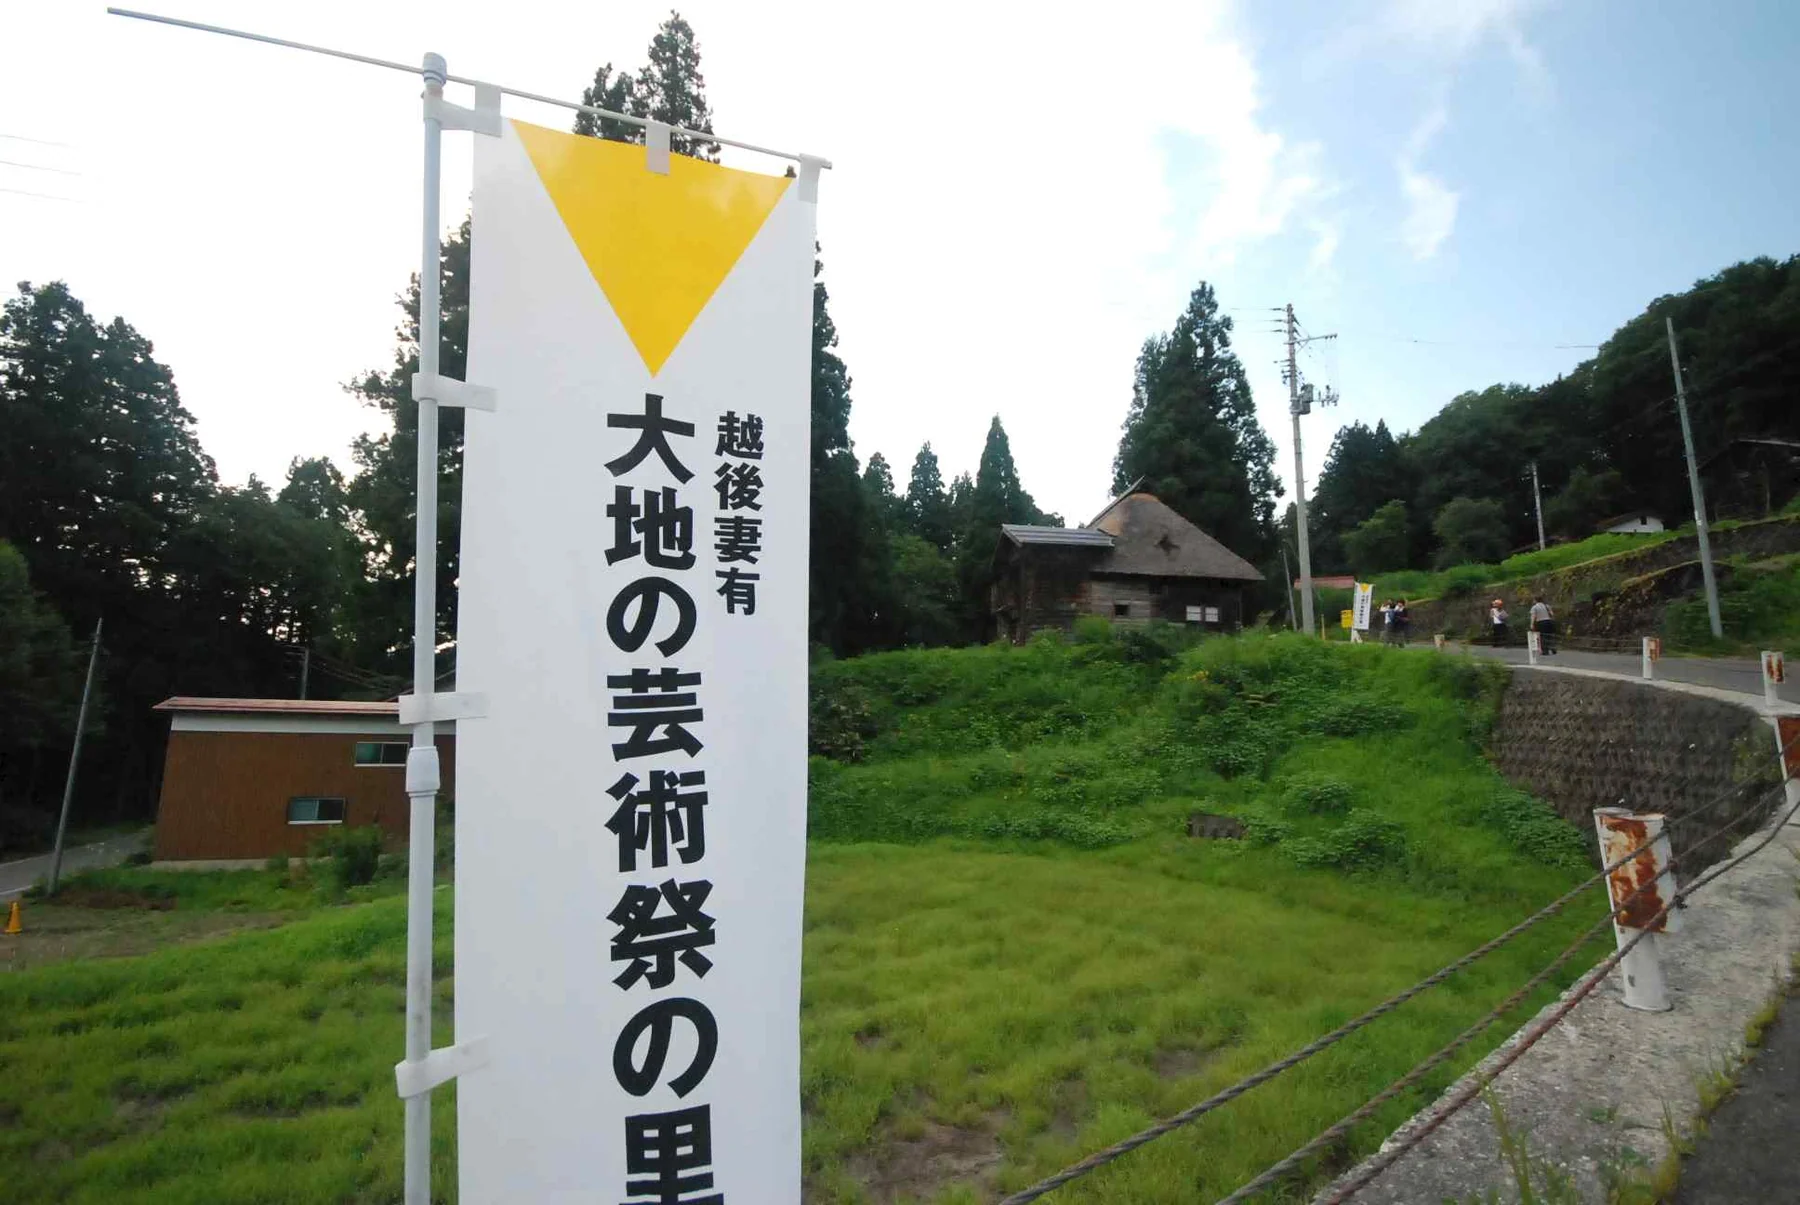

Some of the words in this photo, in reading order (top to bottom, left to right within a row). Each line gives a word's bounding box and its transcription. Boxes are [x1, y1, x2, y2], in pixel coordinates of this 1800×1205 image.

[714, 411, 763, 615] 越後妻有
[605, 394, 724, 1205] 大地の芸術祭の里
